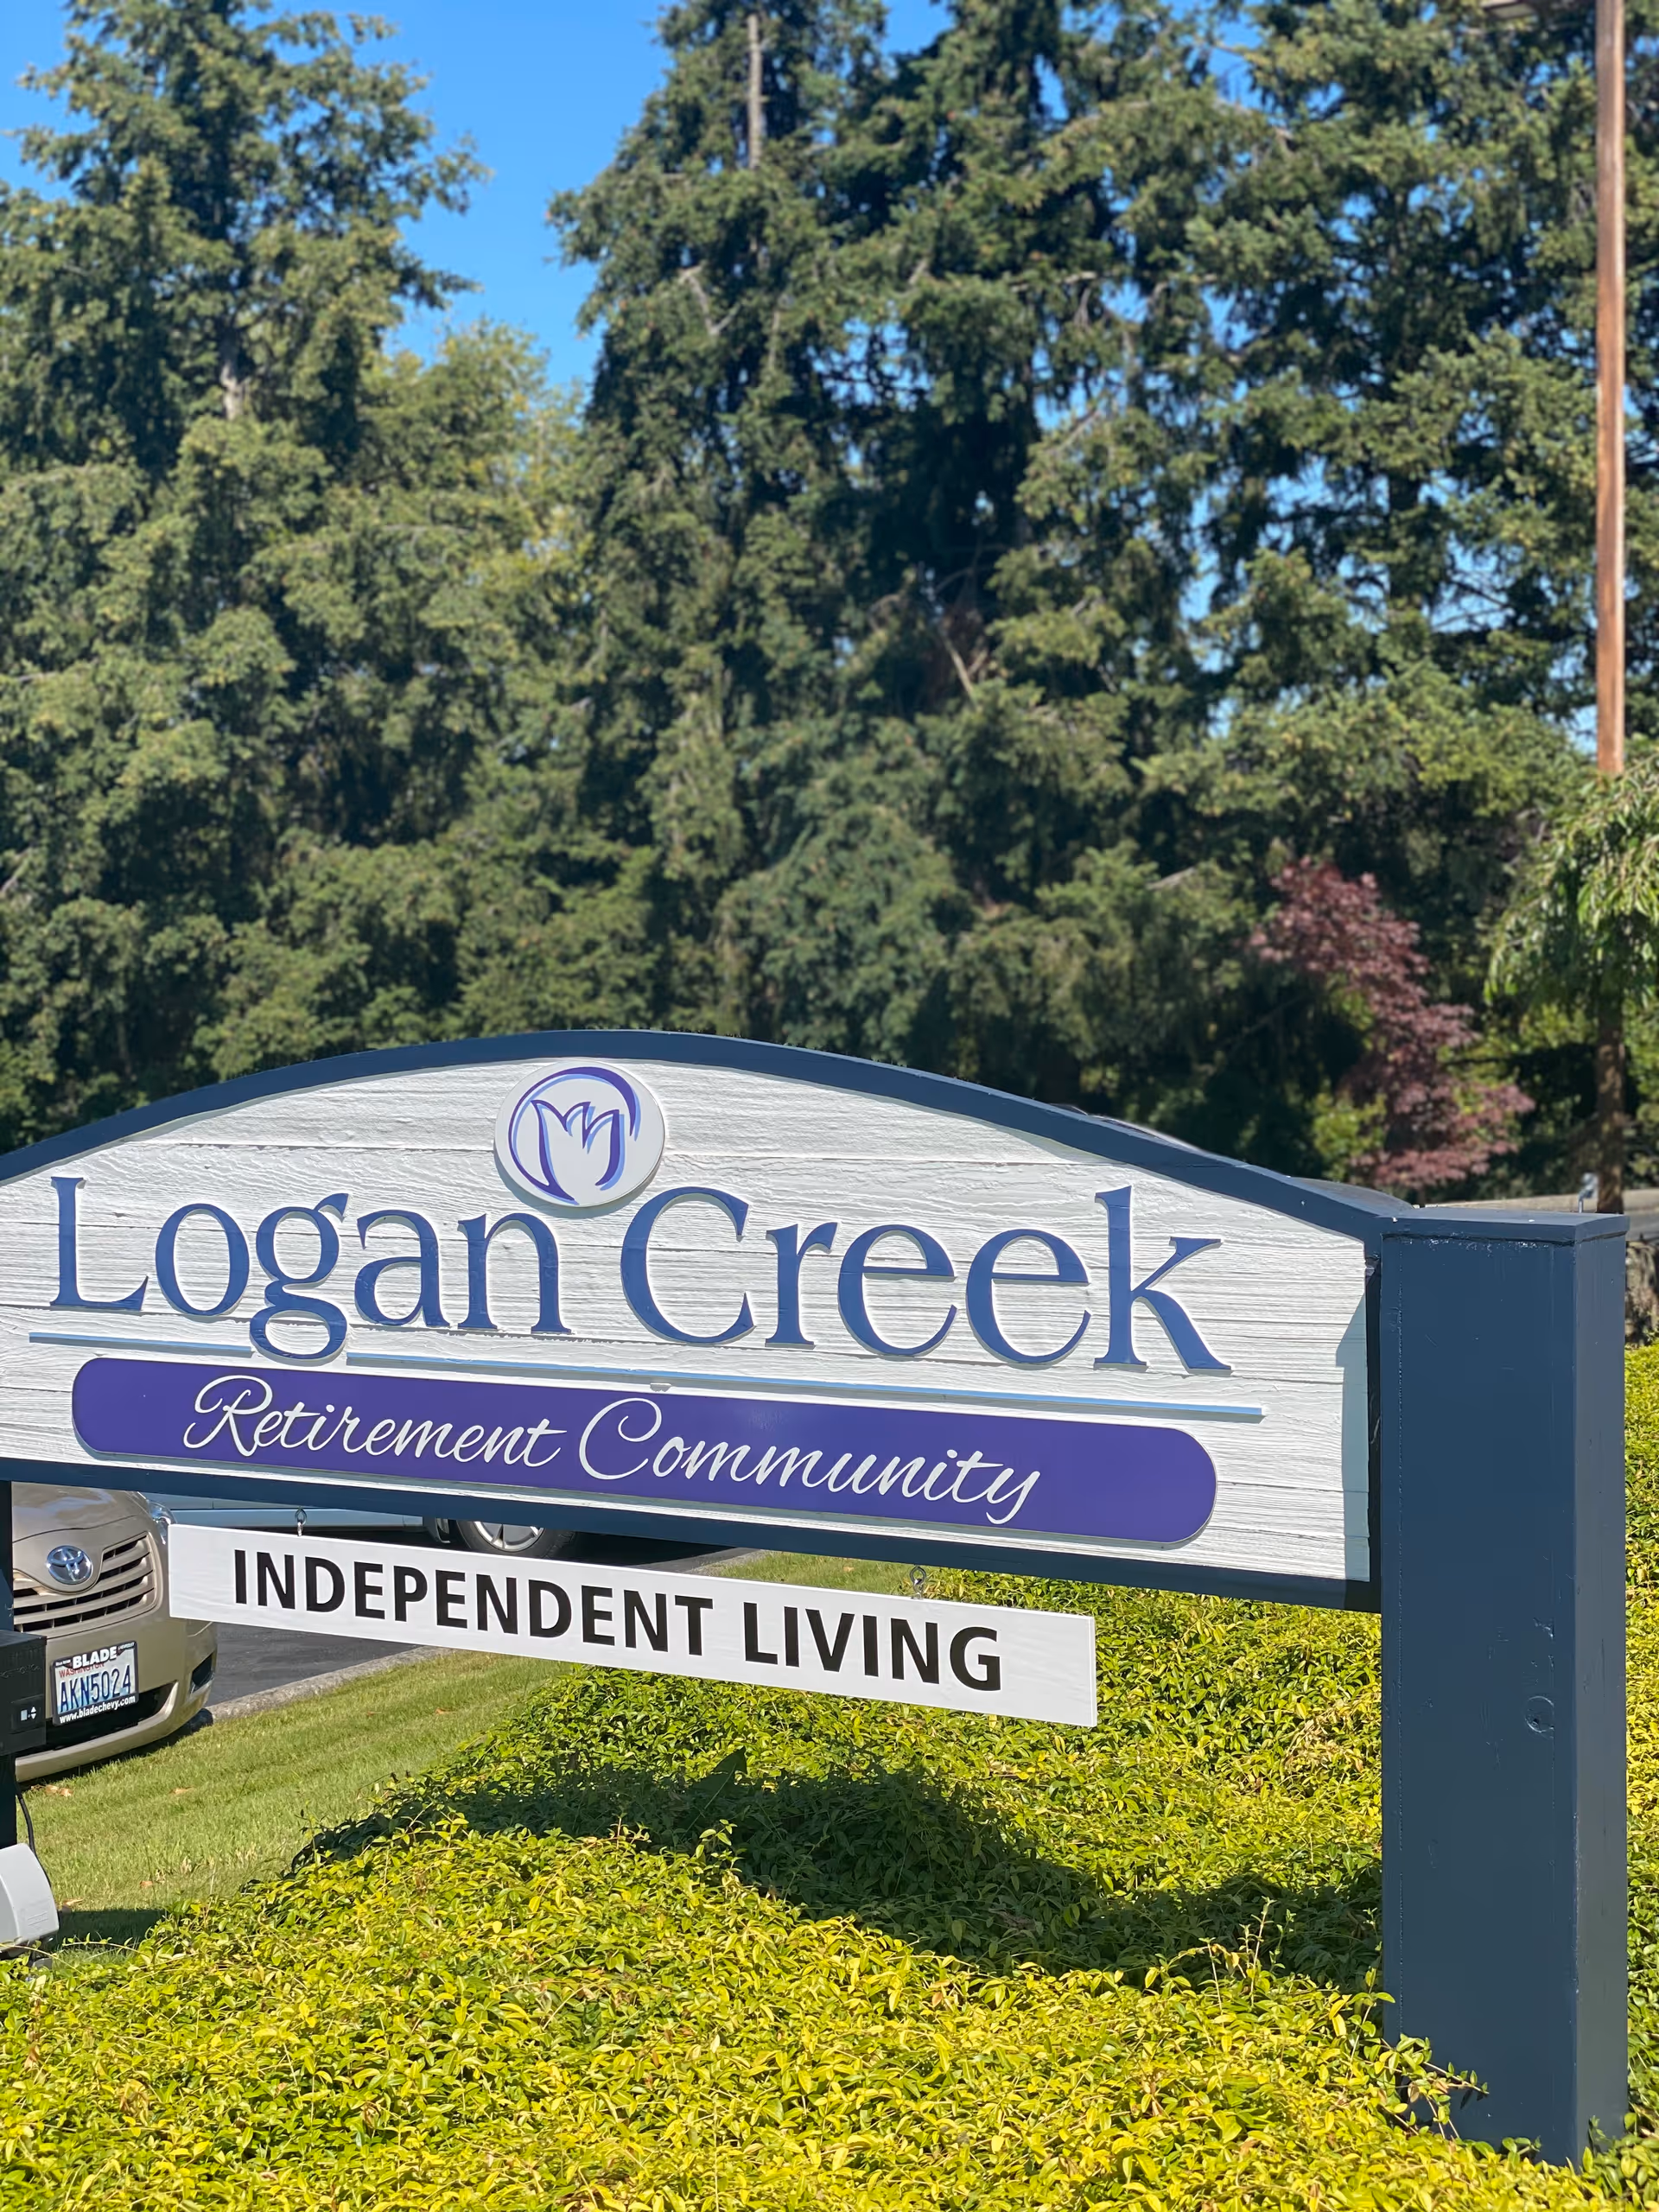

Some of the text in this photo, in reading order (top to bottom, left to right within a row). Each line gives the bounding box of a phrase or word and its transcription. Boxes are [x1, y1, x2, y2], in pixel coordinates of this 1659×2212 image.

[49, 1176, 1233, 1372] Logan Creek
[183, 1374, 1042, 1526] Retirement Community
[72, 1646, 118, 1669] BLADE
[233, 1548, 1002, 1693] INDEPENDENT LIVING
[59, 1695, 137, 1724] www.bladechevy.com
[60, 1664, 132, 1713] AKN5024
